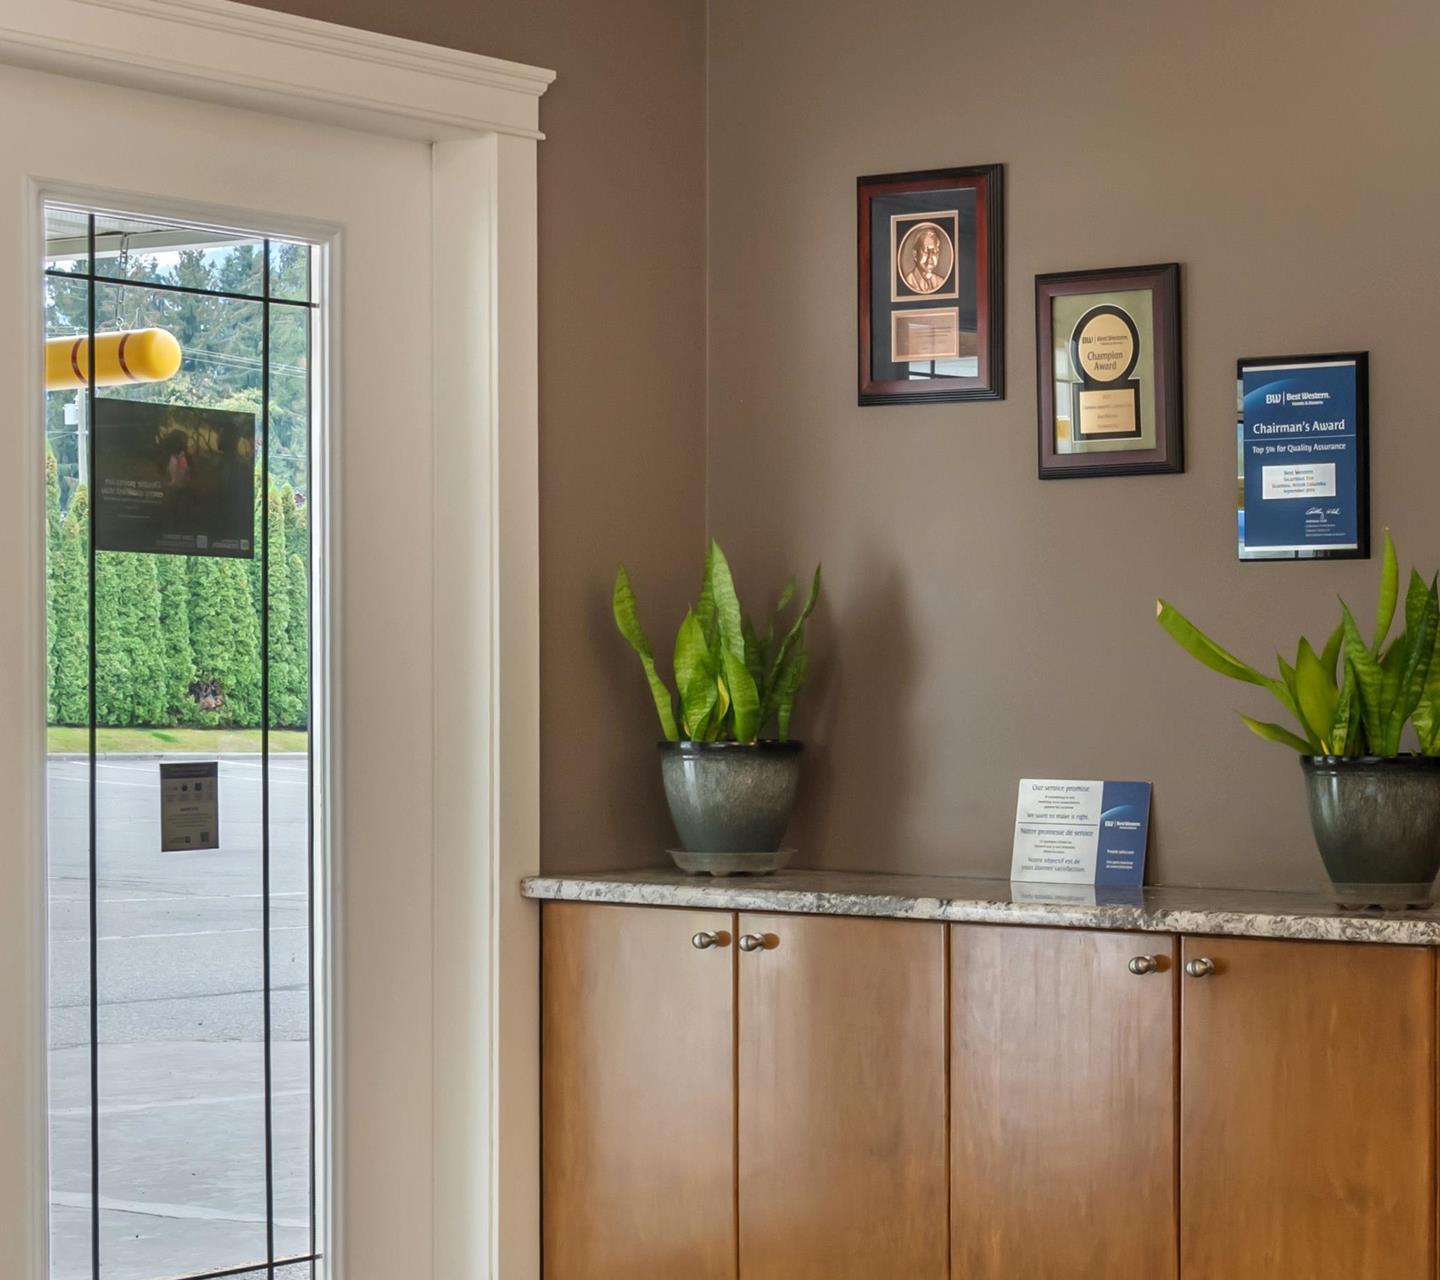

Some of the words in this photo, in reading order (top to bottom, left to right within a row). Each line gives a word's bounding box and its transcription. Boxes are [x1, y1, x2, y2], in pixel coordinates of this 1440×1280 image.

[1087, 351, 1124, 362] Champion
[1094, 361, 1118, 370] Award
[1265, 393, 1281, 404] BW
[1286, 393, 1301, 401] Best
[1253, 421, 1310, 434] Chairman's
[1312, 419, 1345, 431] Award
[1252, 446, 1264, 454] Top
[1287, 444, 1312, 453] Quality
[1313, 443, 1346, 451] Assurance
